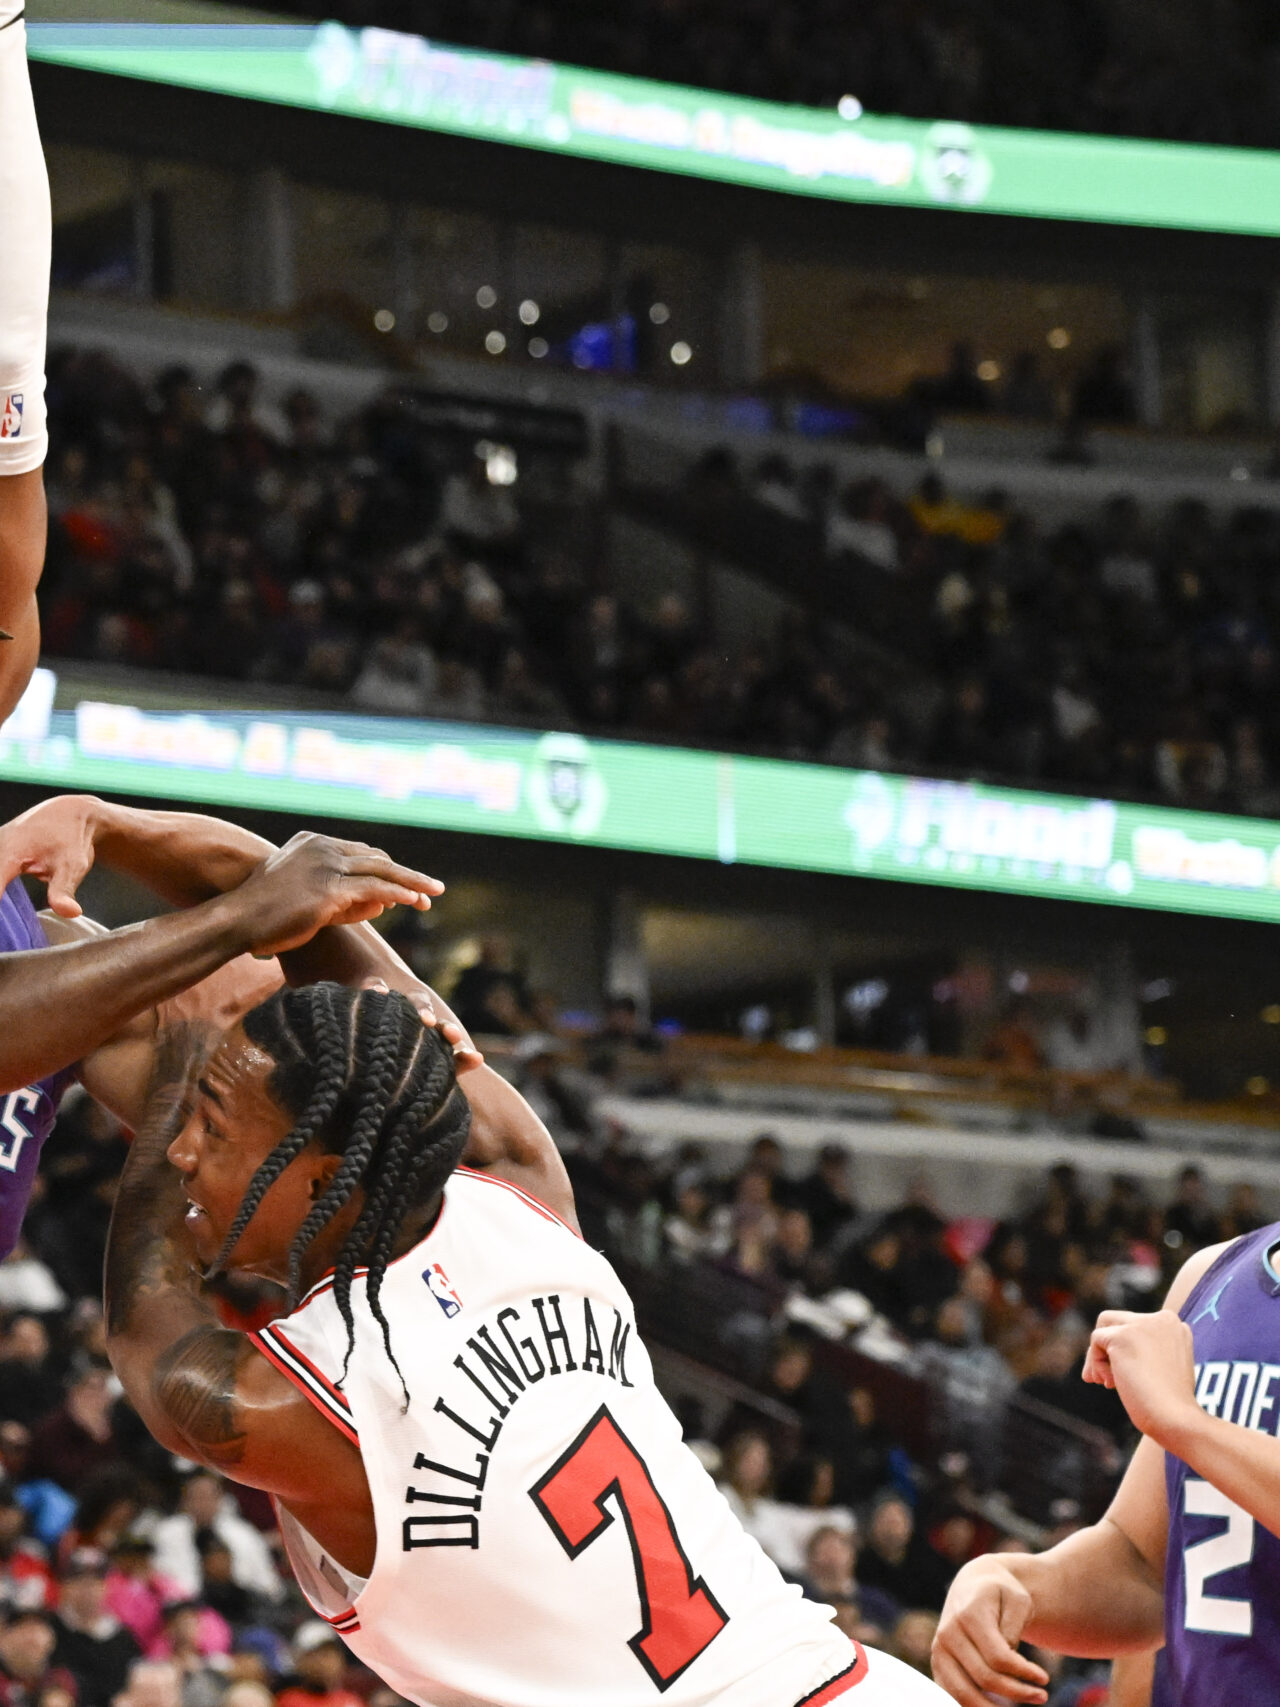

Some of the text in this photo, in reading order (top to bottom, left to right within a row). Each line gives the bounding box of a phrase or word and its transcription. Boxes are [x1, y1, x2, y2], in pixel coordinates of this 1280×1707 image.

[402, 1294, 635, 1552] DILLINGHAM
[527, 1402, 731, 1693] 7
[1183, 1478, 1254, 1636] 2
